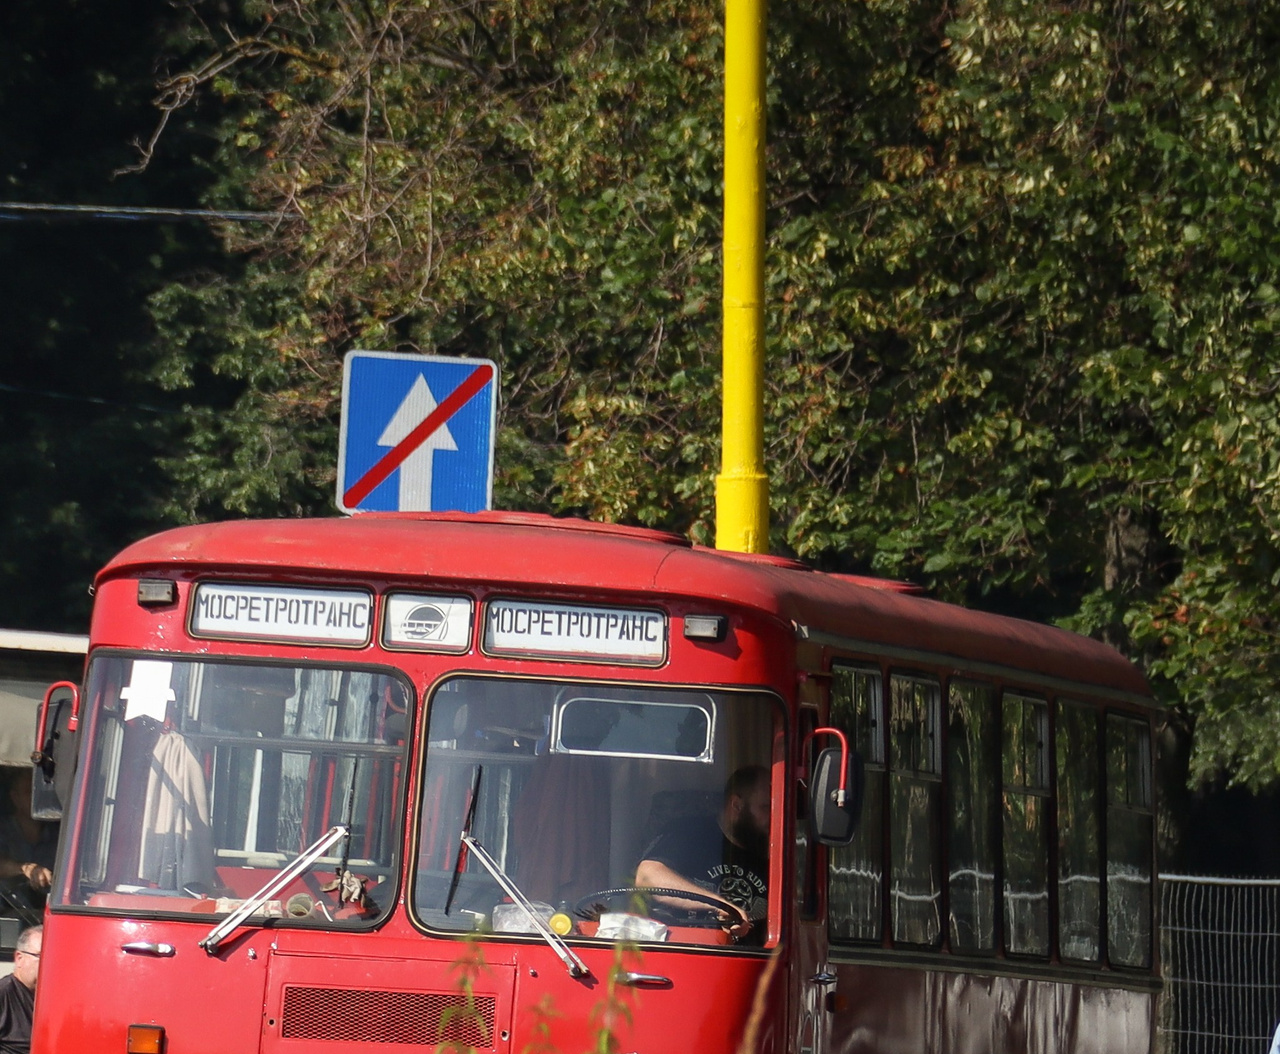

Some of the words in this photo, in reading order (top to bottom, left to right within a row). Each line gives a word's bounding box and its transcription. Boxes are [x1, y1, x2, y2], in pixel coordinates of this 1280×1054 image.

[197, 593, 368, 629] МОСРЕТРОТРАНС
[487, 606, 660, 643] МОСРЕТРОТРАНС
[707, 864, 731, 879] LIVE
[732, 864, 744, 877] TO
[745, 871, 767, 894] RIDE
